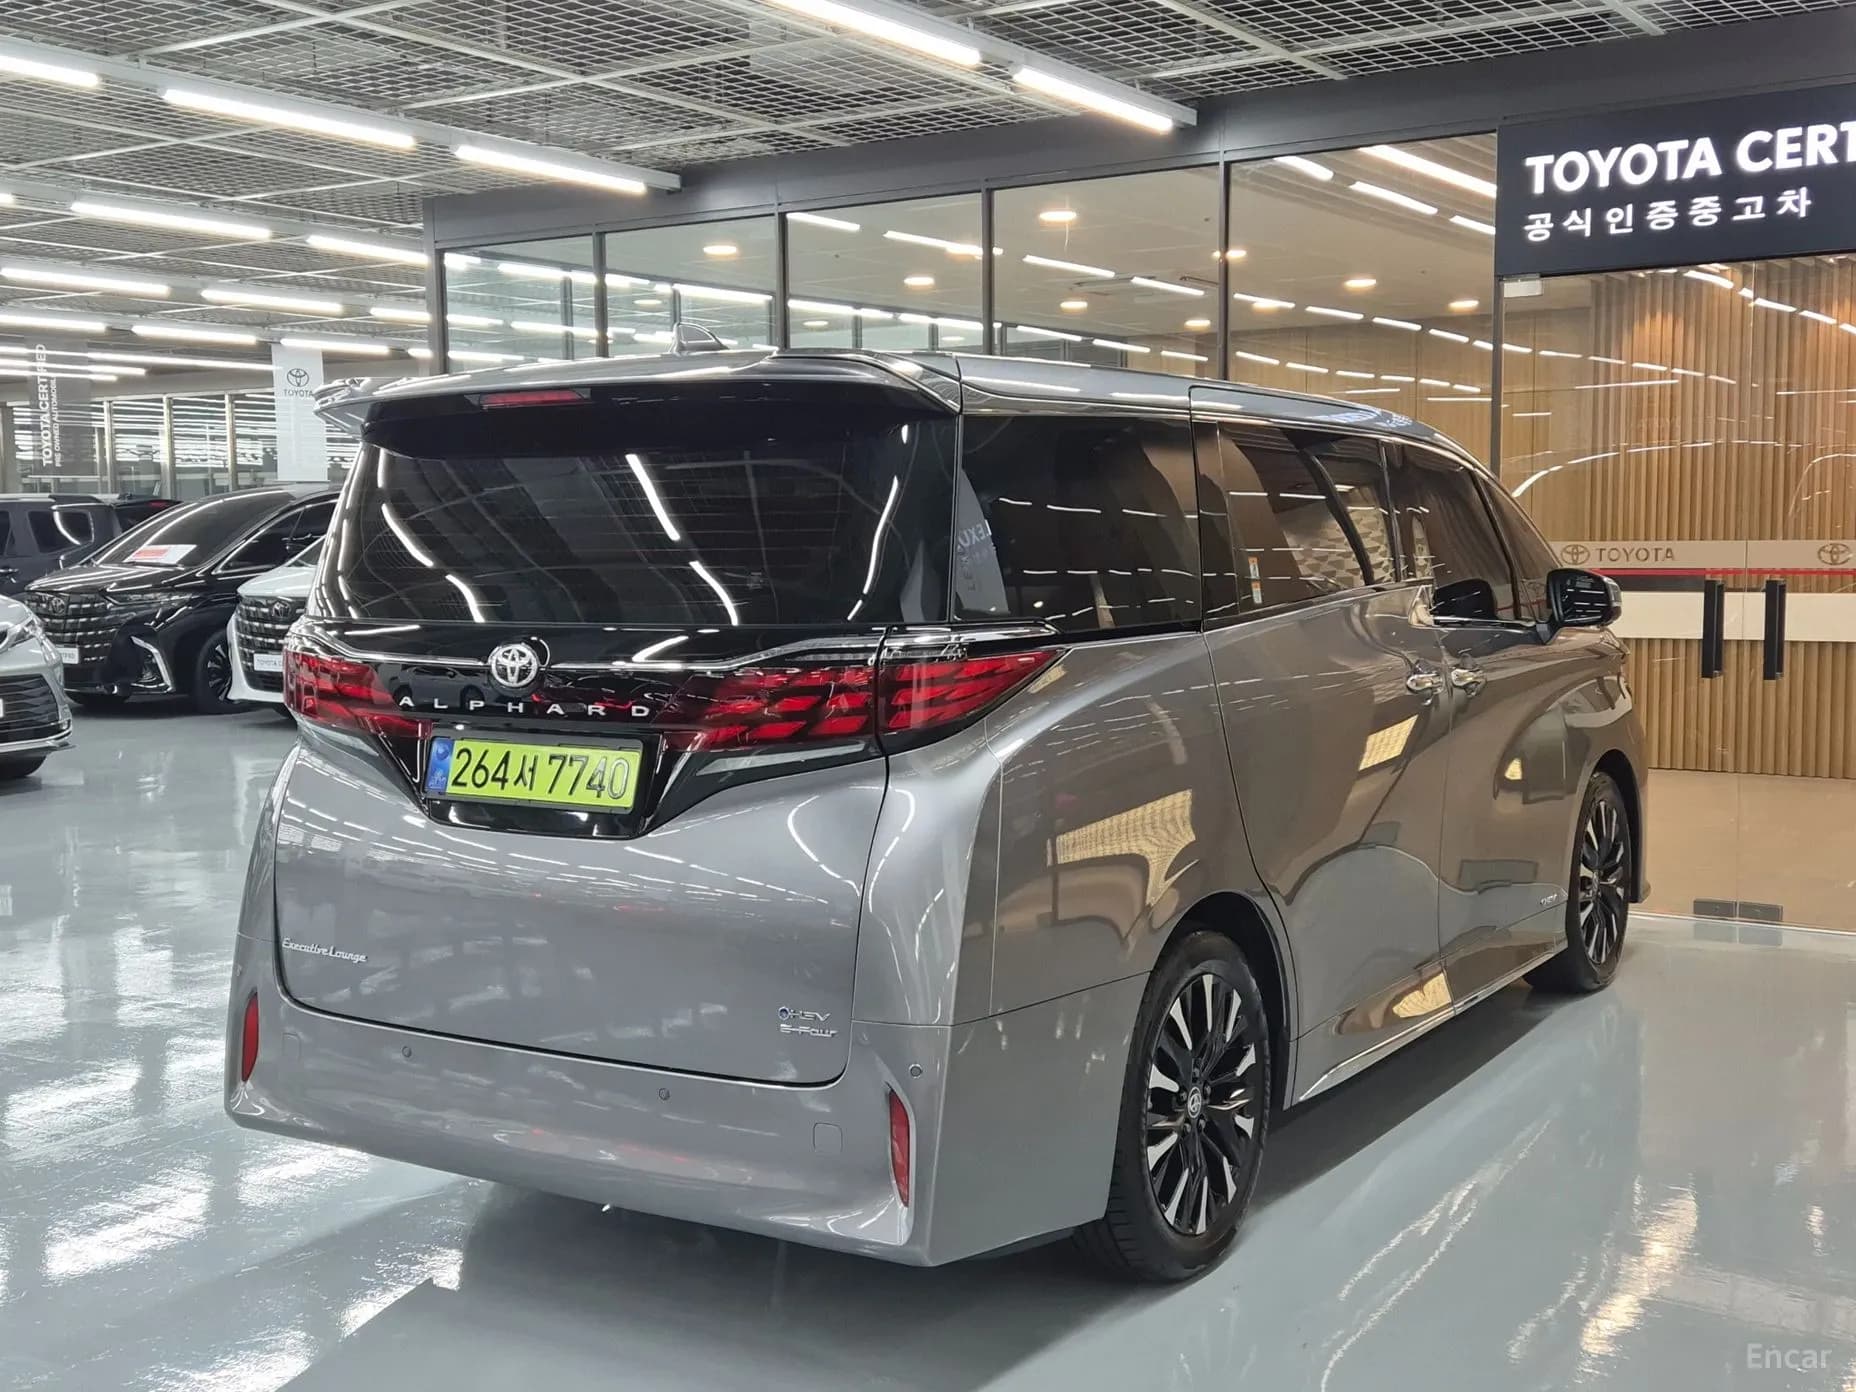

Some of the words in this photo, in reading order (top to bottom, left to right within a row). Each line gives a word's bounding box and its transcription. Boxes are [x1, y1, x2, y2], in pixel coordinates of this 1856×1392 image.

[1524, 137, 1722, 194] TOYOTA
[36, 344, 49, 410] CERTFED
[50, 374, 58, 421] AUTOMOBIL
[284, 389, 314, 398] TOYOTA
[40, 411, 53, 467] TOYOTA
[1596, 547, 1675, 563] TOYOTA
[399, 696, 650, 717] ALPHARD
[451, 747, 537, 791] 264서
[548, 754, 630, 800] 7740
[282, 937, 328, 956] Executive
[328, 945, 366, 964] Lounge
